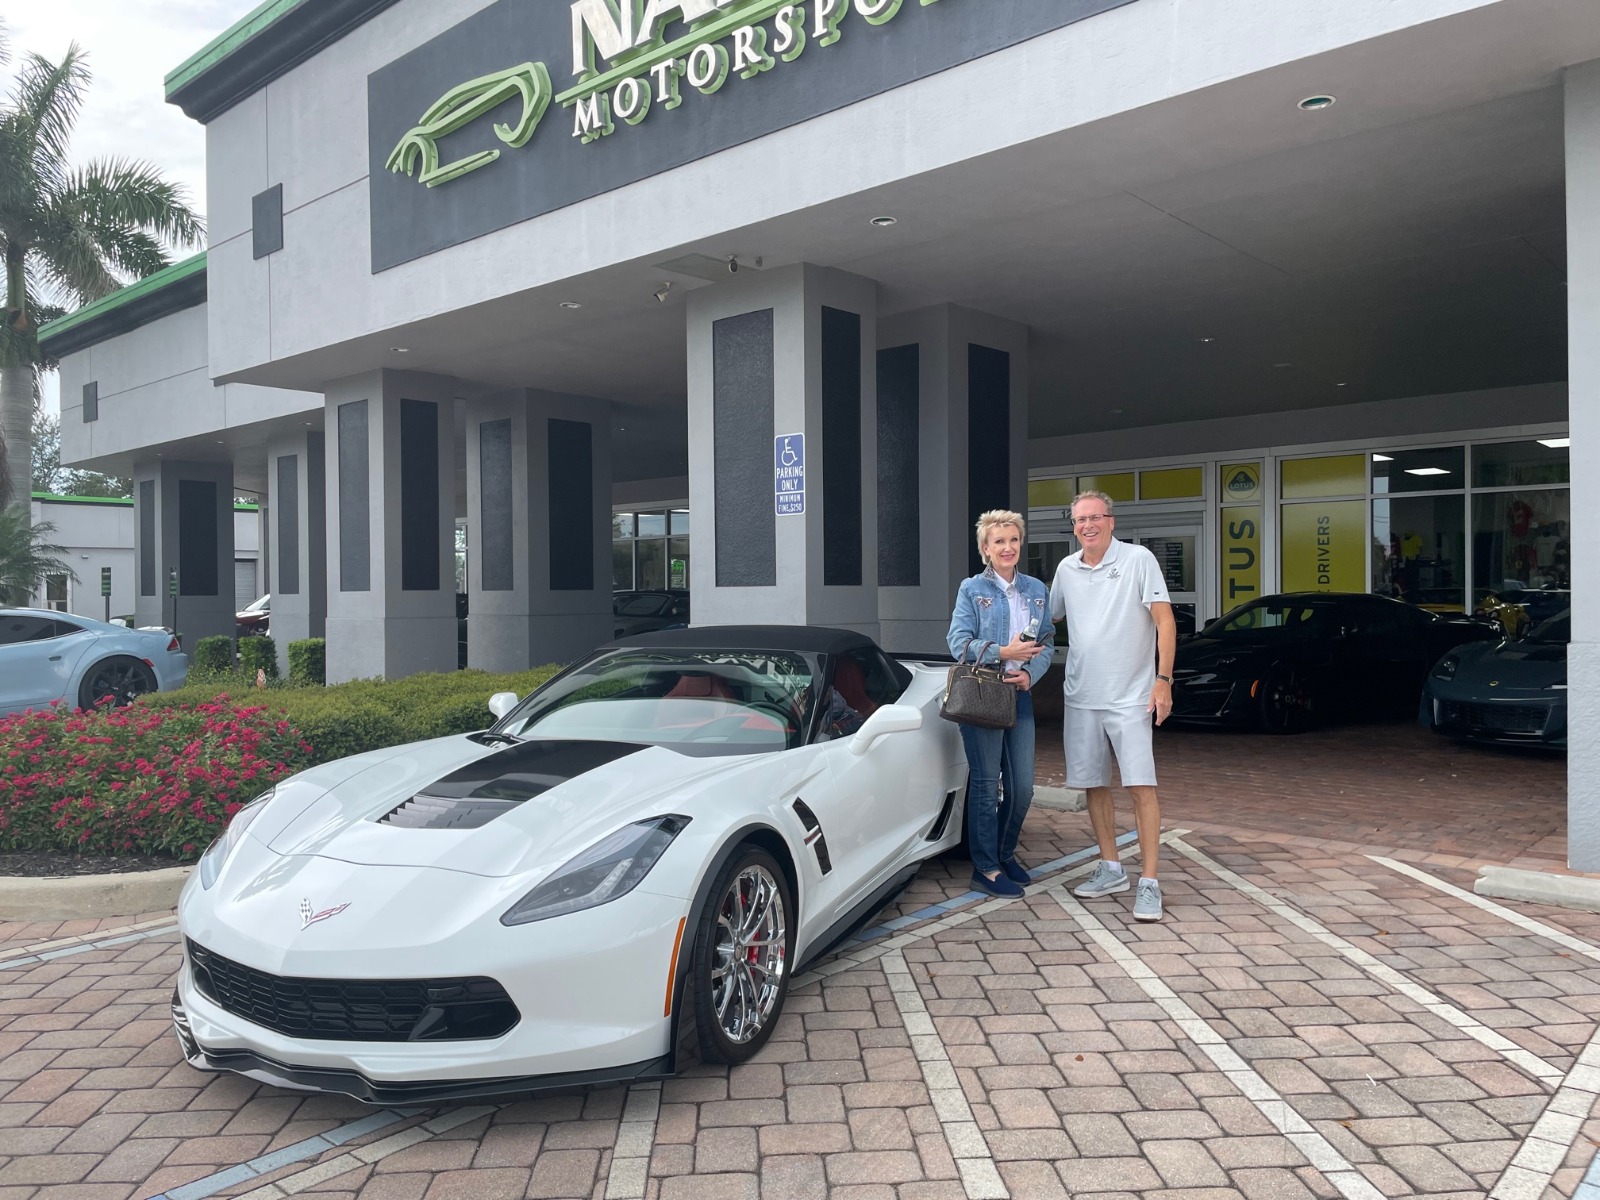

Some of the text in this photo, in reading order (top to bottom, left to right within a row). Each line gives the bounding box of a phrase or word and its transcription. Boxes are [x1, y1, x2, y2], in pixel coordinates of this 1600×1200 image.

[776, 465, 803, 479] PARKING
[781, 479, 798, 491] ONLY
[1229, 481, 1254, 489] LOTUS
[779, 494, 801, 503] MINIMUM
[1317, 515, 1330, 585] DRIVERS
